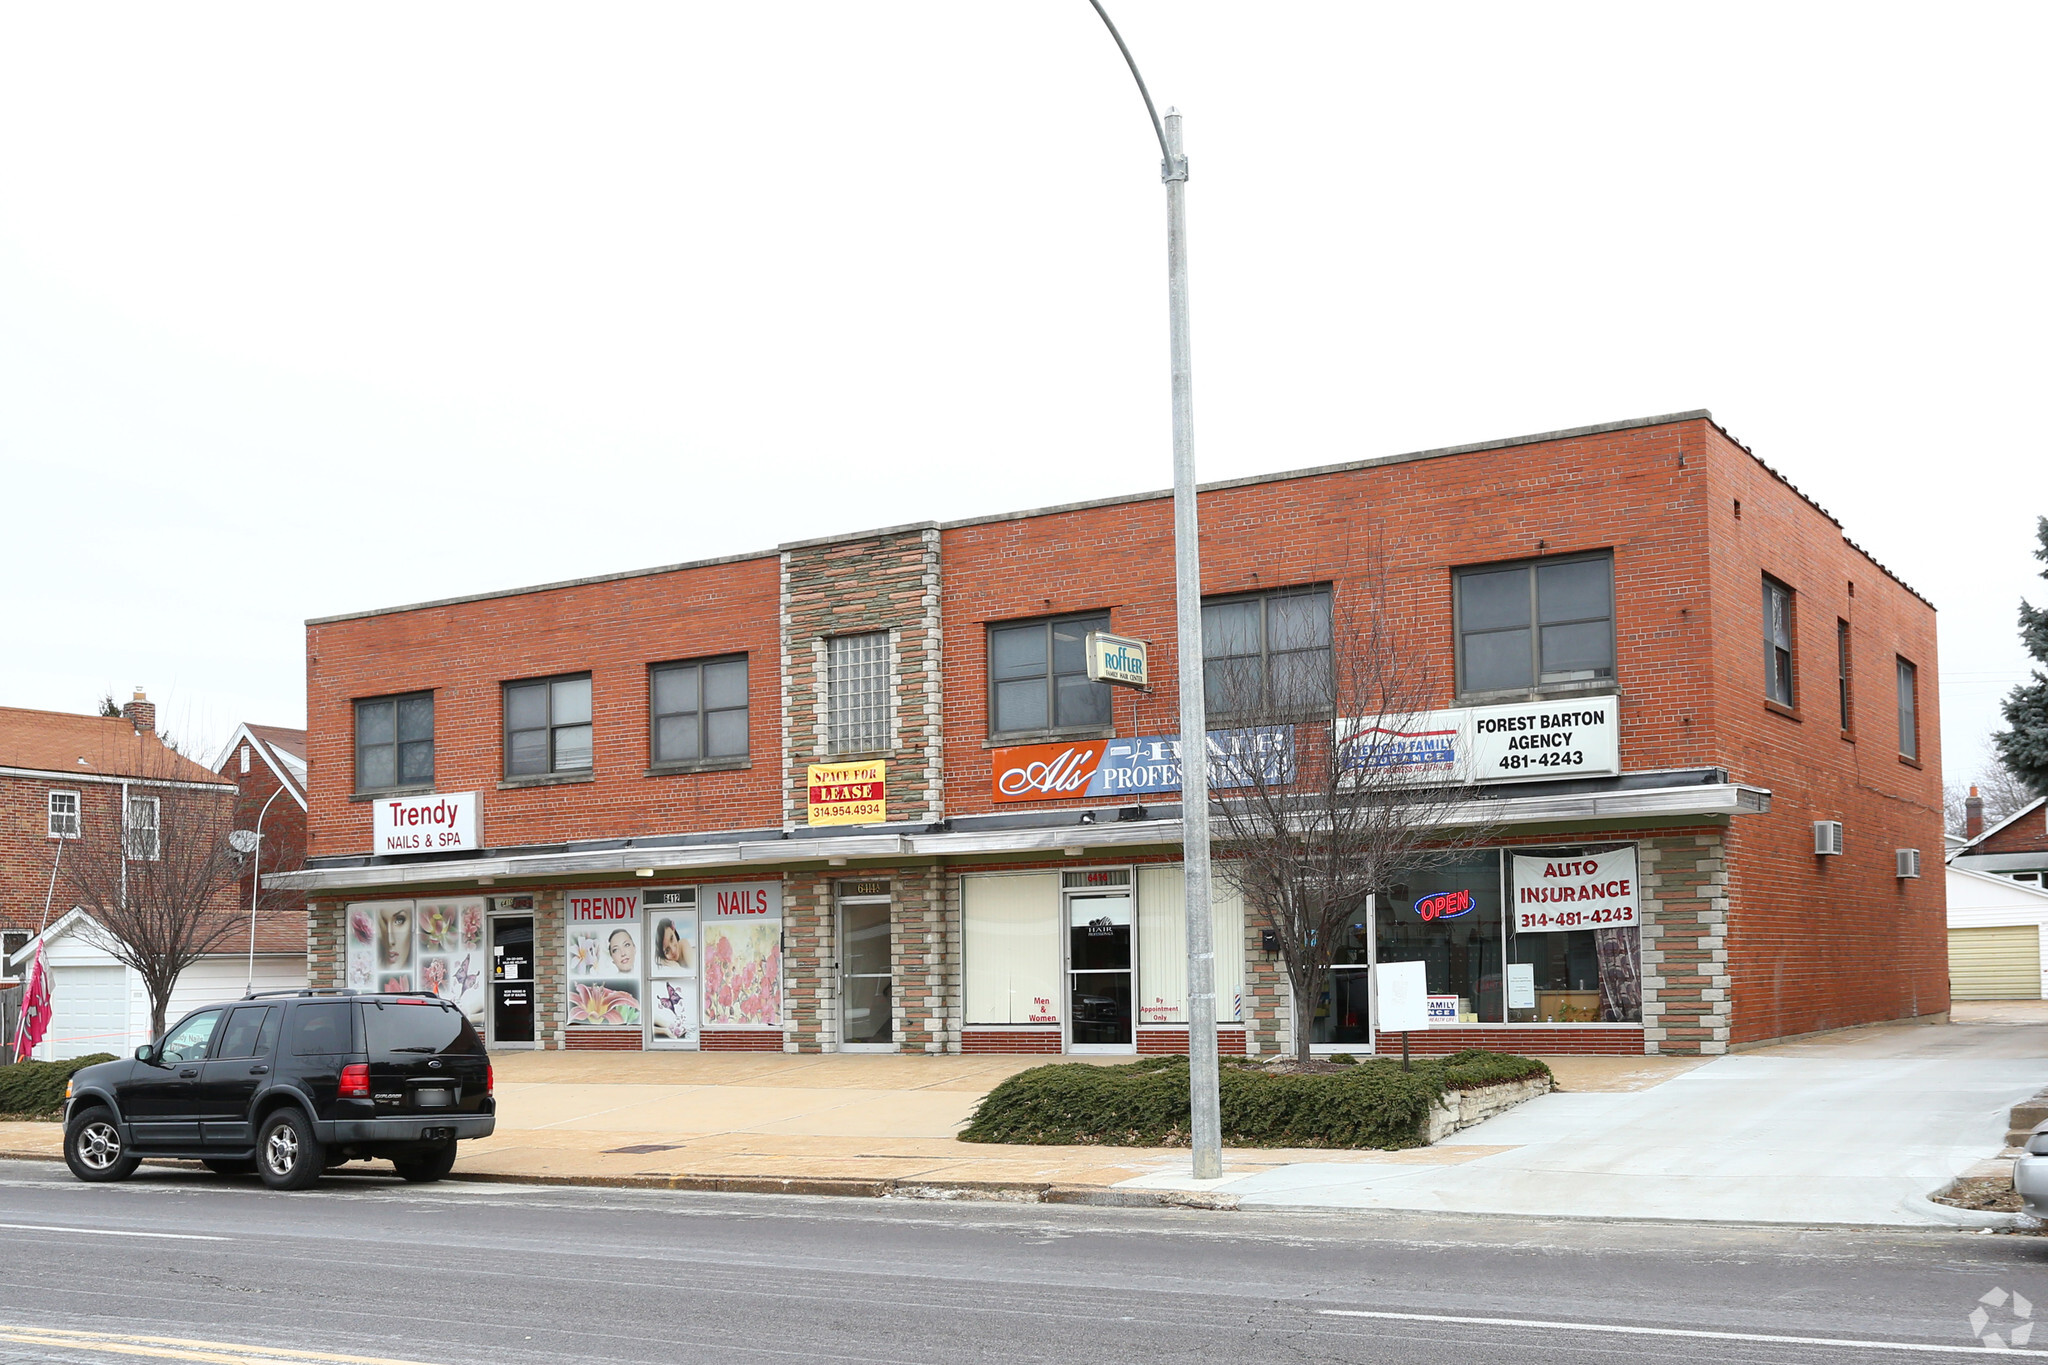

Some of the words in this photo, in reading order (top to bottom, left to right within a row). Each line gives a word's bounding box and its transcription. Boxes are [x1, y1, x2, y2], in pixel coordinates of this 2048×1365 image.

[1477, 716, 1537, 734] FOREST
[1540, 710, 1605, 729] BARTON
[1409, 738, 1454, 751] FAMILY
[1508, 732, 1573, 750] AGENCY
[1499, 750, 1584, 769] 481-4243
[814, 770, 850, 783] SPACE
[854, 768, 877, 780] FOR
[998, 748, 1097, 795] Al's
[820, 784, 873, 801] LEASE
[389, 799, 458, 828] Trendy
[813, 804, 880, 818] 314.954.4934
[387, 834, 420, 850] NAILS
[425, 833, 433, 848] &
[438, 831, 461, 847] SPA
[1543, 860, 1599, 878] AUTO
[1520, 879, 1632, 904] INSURANCE
[570, 896, 637, 921] TRENDY
[717, 889, 768, 915] NAILS
[1421, 889, 1469, 921] OPEN
[1521, 906, 1634, 928] 314-481-4243
[1034, 997, 1050, 1005] Men
[1040, 1005, 1046, 1013] &
[1029, 1014, 1057, 1022] Women
